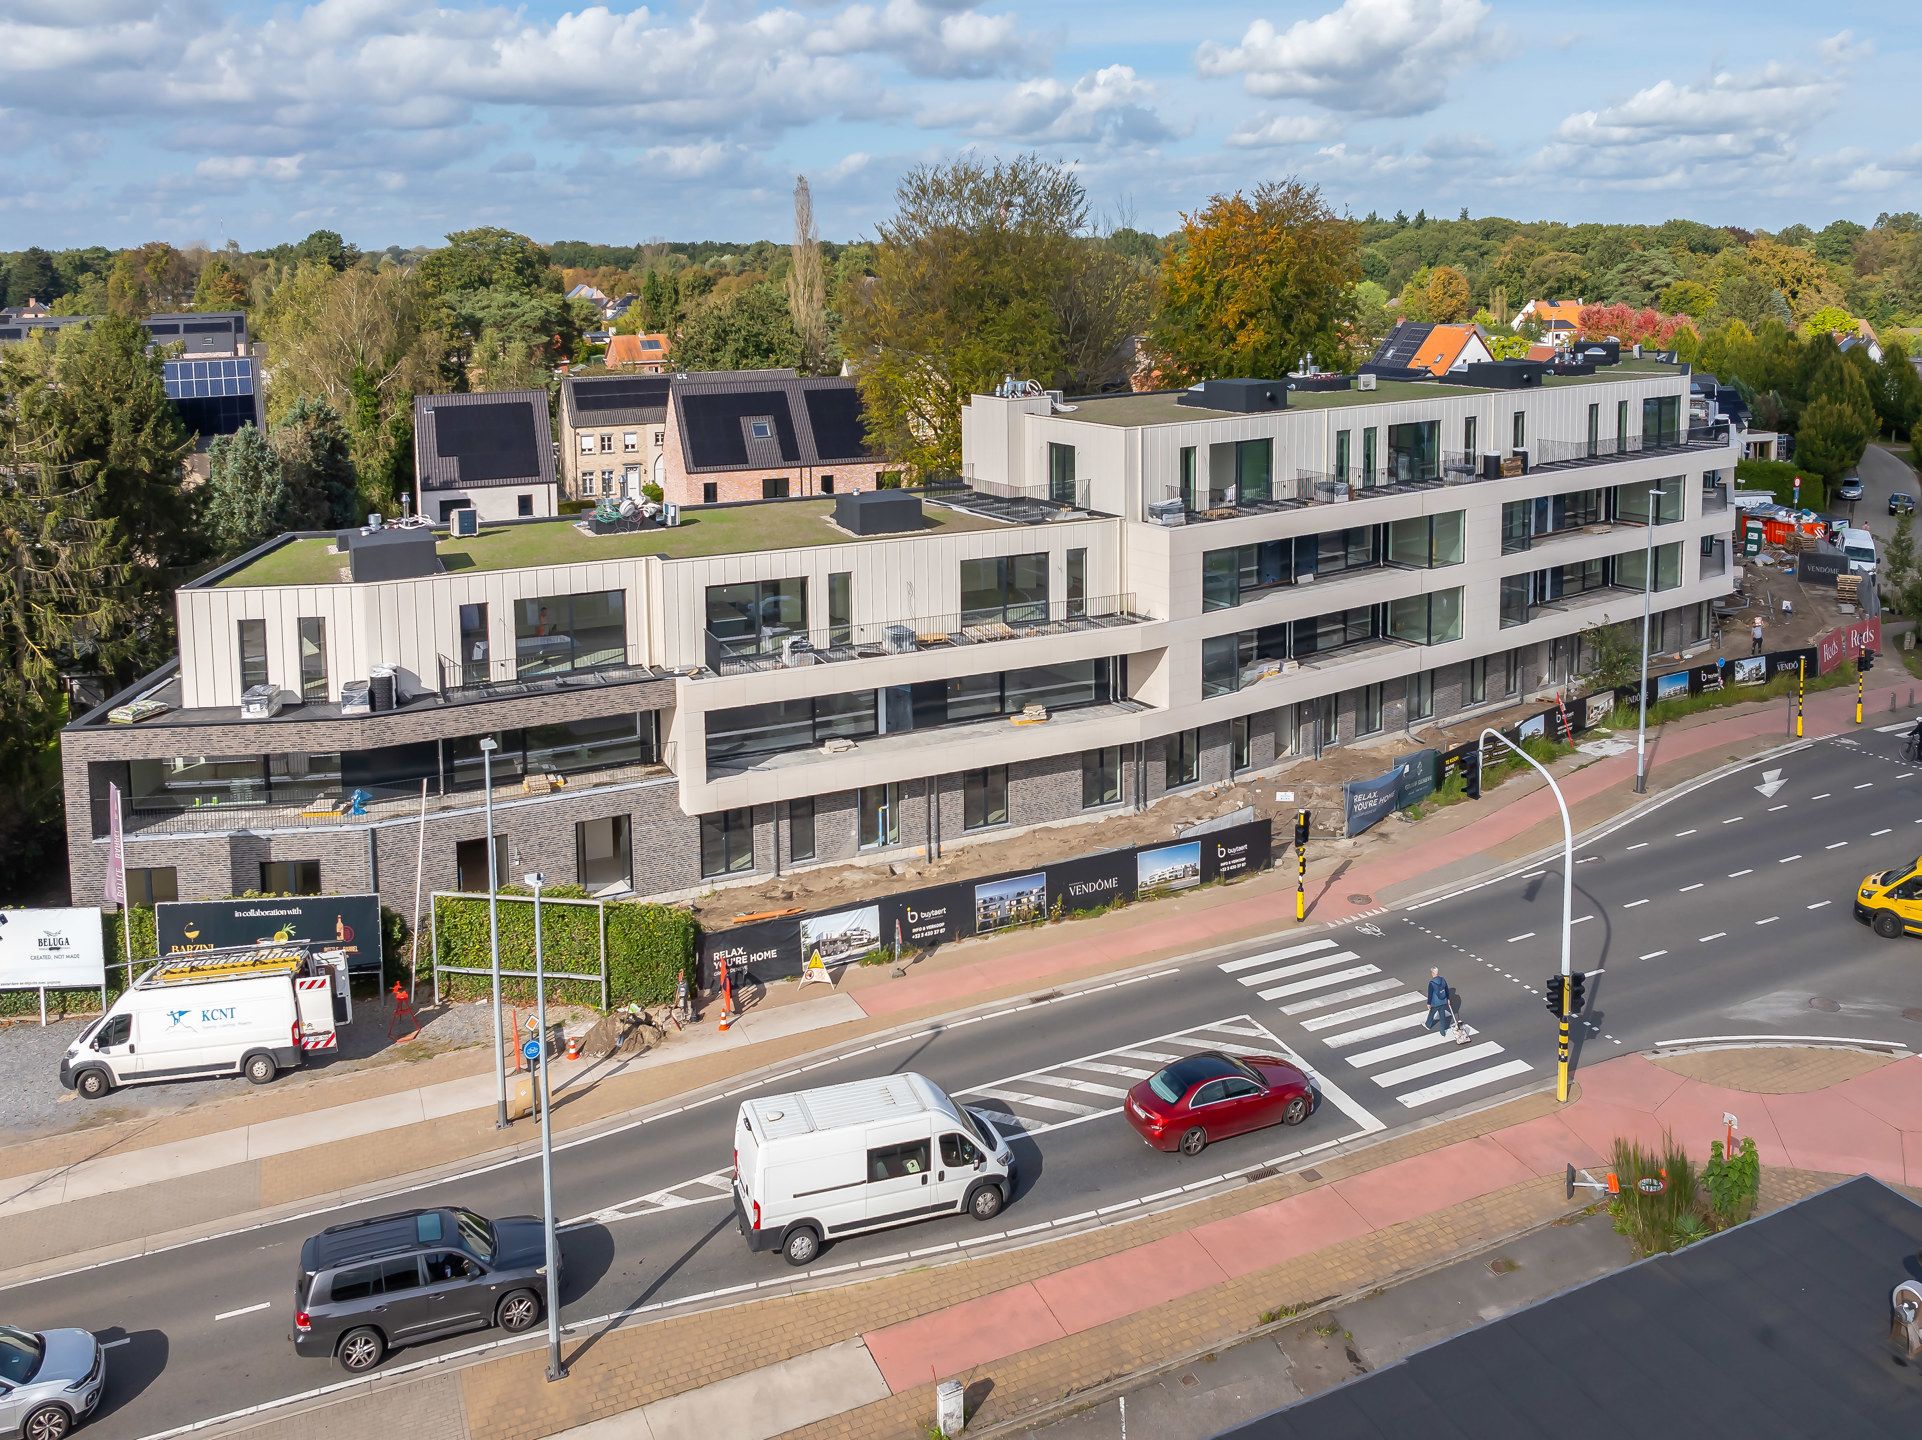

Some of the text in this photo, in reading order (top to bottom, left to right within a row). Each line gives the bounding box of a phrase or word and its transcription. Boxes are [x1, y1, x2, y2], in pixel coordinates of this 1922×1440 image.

[1823, 640, 1839, 662] Reds
[1353, 791, 1379, 803] RELAX.
[1353, 798, 1378, 813] YOU'RE
[1069, 877, 1119, 896] VENDÔME
[242, 908, 287, 917] collaboration
[287, 907, 302, 915] with
[920, 907, 947, 919] buytaert
[38, 937, 70, 947] BELUGA
[713, 947, 747, 961] RELAX.
[713, 949, 777, 970] YU'RE HOME
[202, 1007, 237, 1022] KCNT
